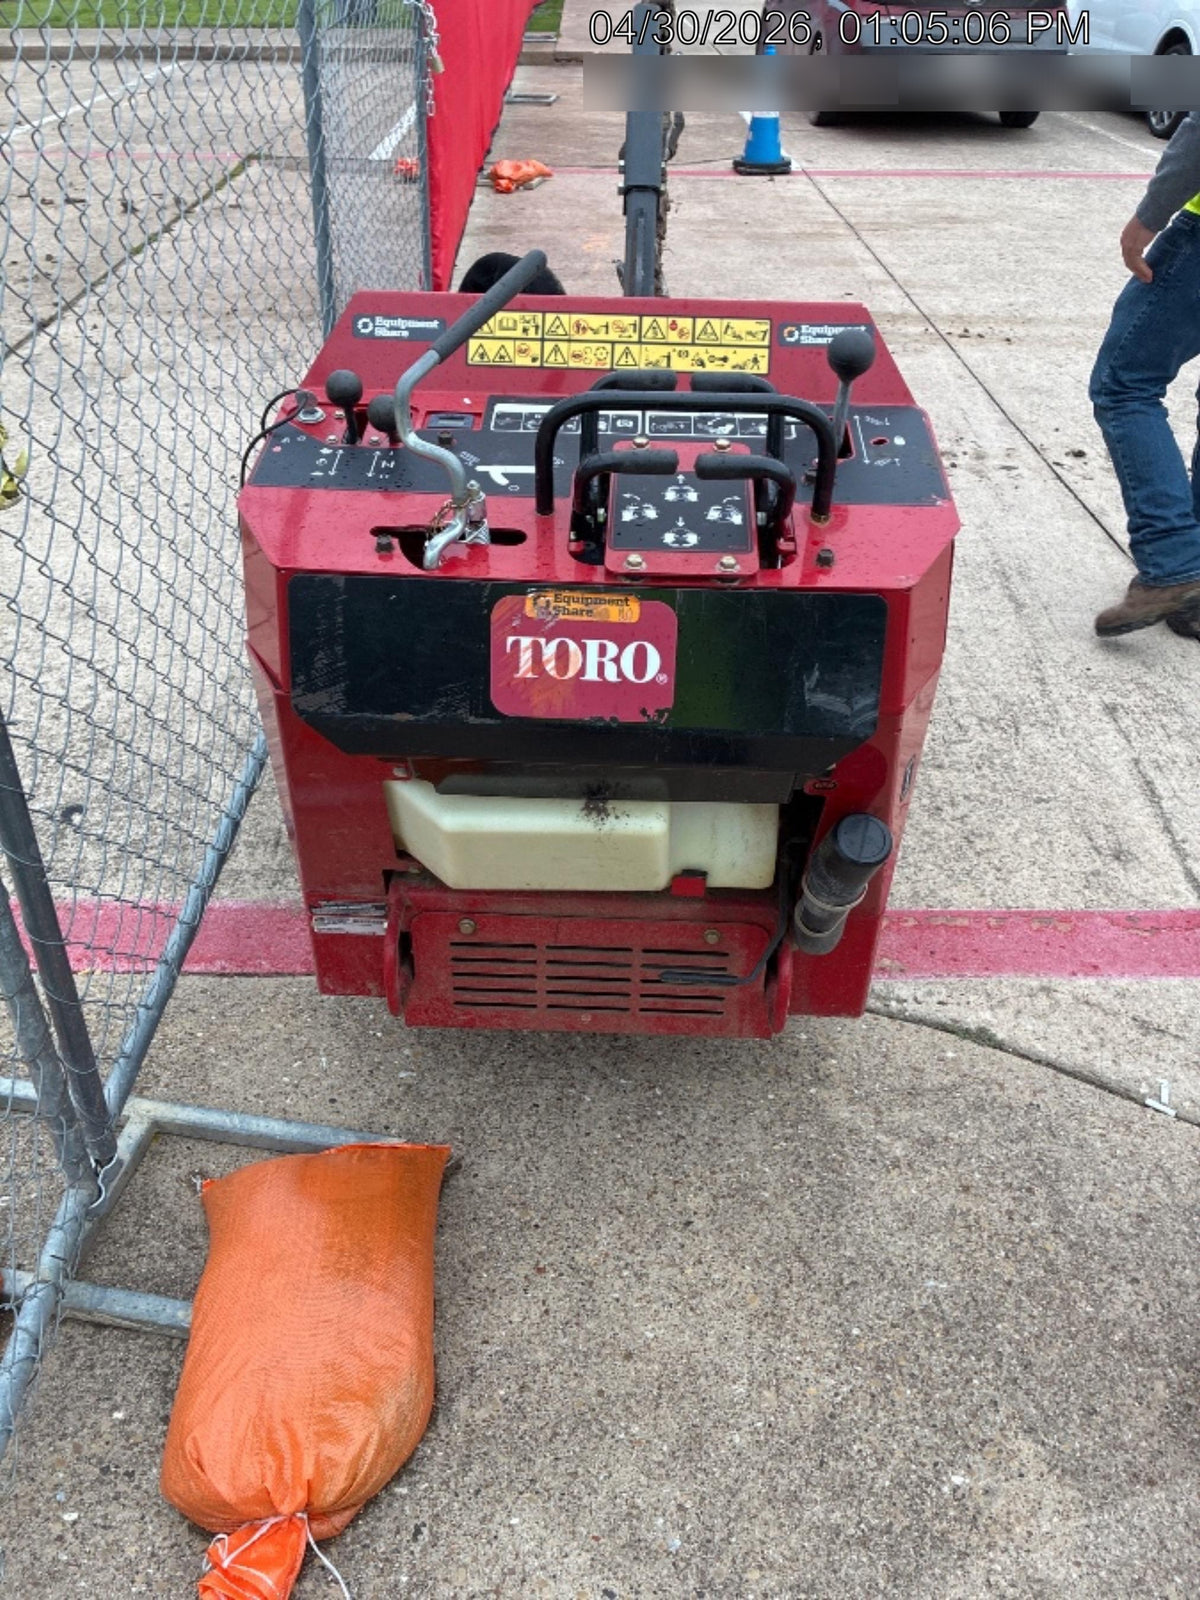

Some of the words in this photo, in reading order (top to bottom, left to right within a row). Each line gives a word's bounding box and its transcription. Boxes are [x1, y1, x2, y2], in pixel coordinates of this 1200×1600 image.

[374, 316, 440, 329] Equipment
[553, 593, 630, 607] Equipment
[552, 604, 594, 616] Share
